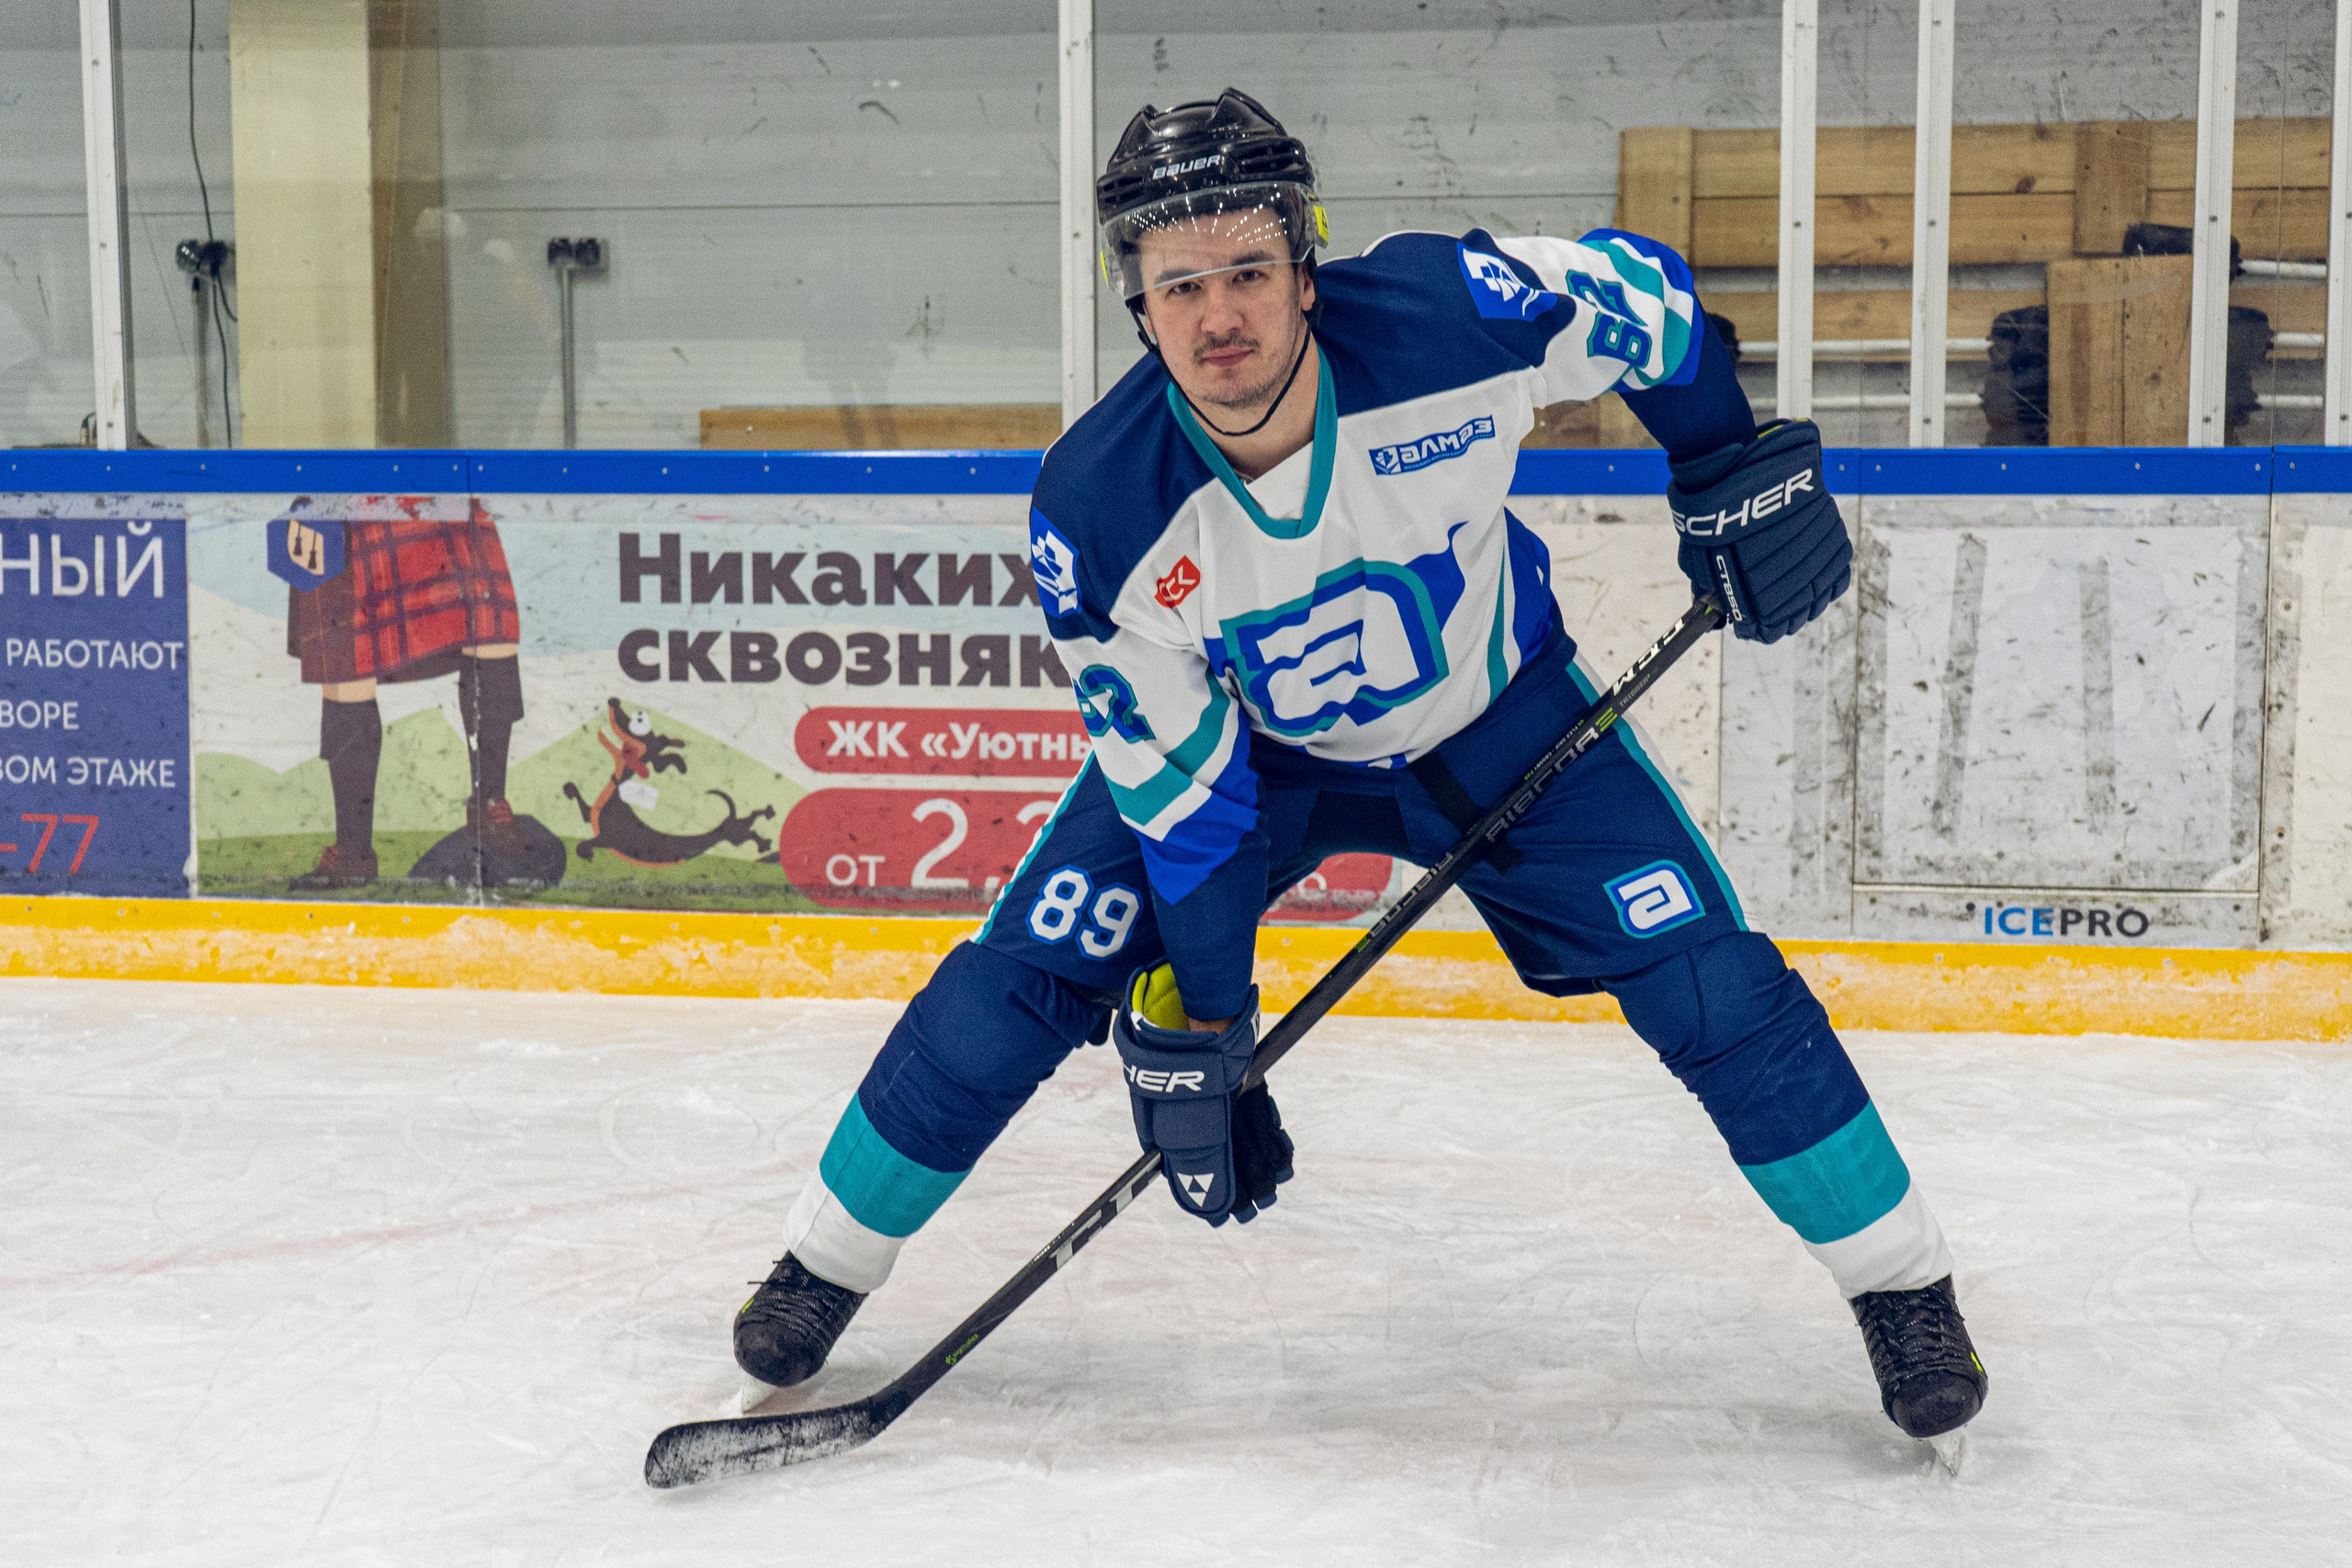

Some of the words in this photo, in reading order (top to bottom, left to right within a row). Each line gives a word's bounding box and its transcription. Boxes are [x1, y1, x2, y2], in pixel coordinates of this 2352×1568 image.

[1152, 153, 1223, 180] BAUER
[0, 521, 164, 598] НЫЙ
[618, 532, 1041, 607] Никаких
[6, 637, 184, 671] РАБОТАЮТ
[826, 721, 910, 759] ЖК
[0, 755, 57, 784] ОМ
[66, 756, 175, 788] ЭТАЖЕ
[826, 854, 886, 888] от
[1025, 863, 1144, 961] 89
[1984, 906, 2151, 938] ICEPRO
